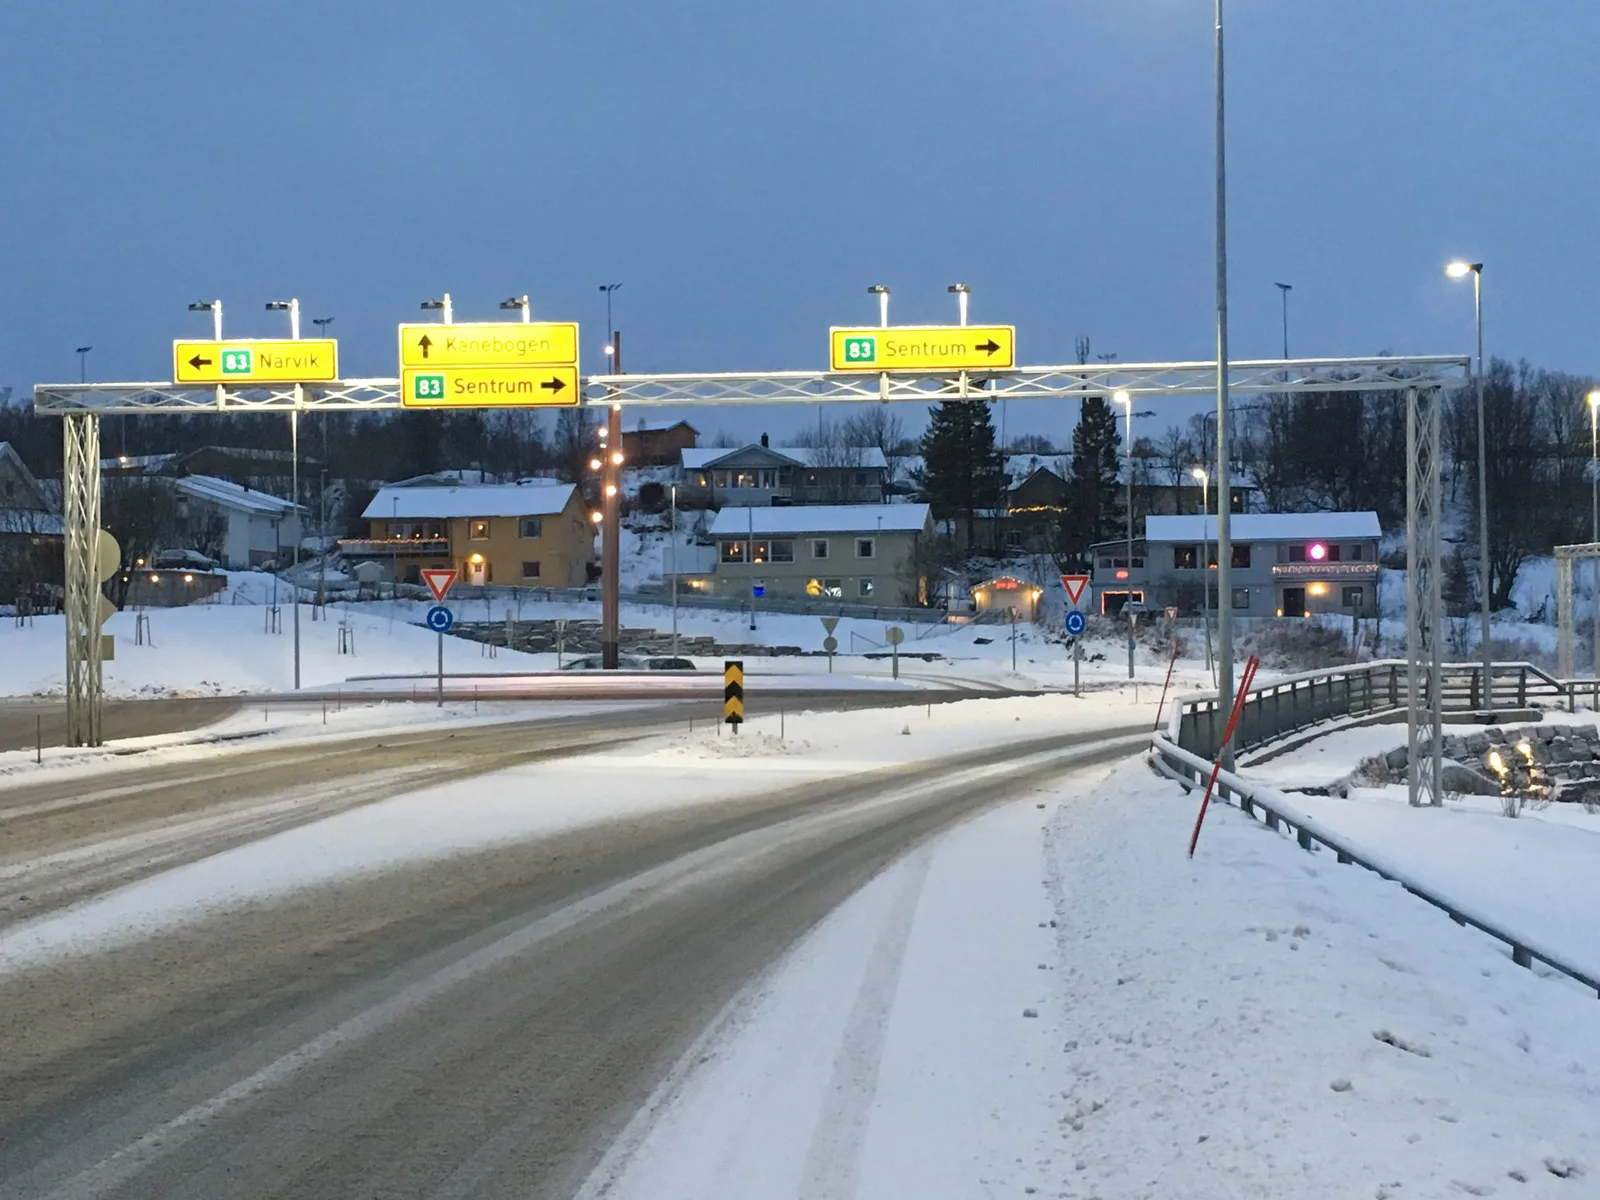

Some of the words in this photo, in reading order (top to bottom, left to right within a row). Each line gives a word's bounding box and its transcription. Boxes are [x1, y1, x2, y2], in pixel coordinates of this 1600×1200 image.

[446, 336, 550, 356] Kanebogen
[849, 342, 871, 359] 83
[885, 340, 967, 357] Sentrum
[225, 353, 248, 371] 83
[260, 353, 320, 369] Narvik
[418, 379, 441, 396] 83
[454, 378, 533, 394] Sentrum
